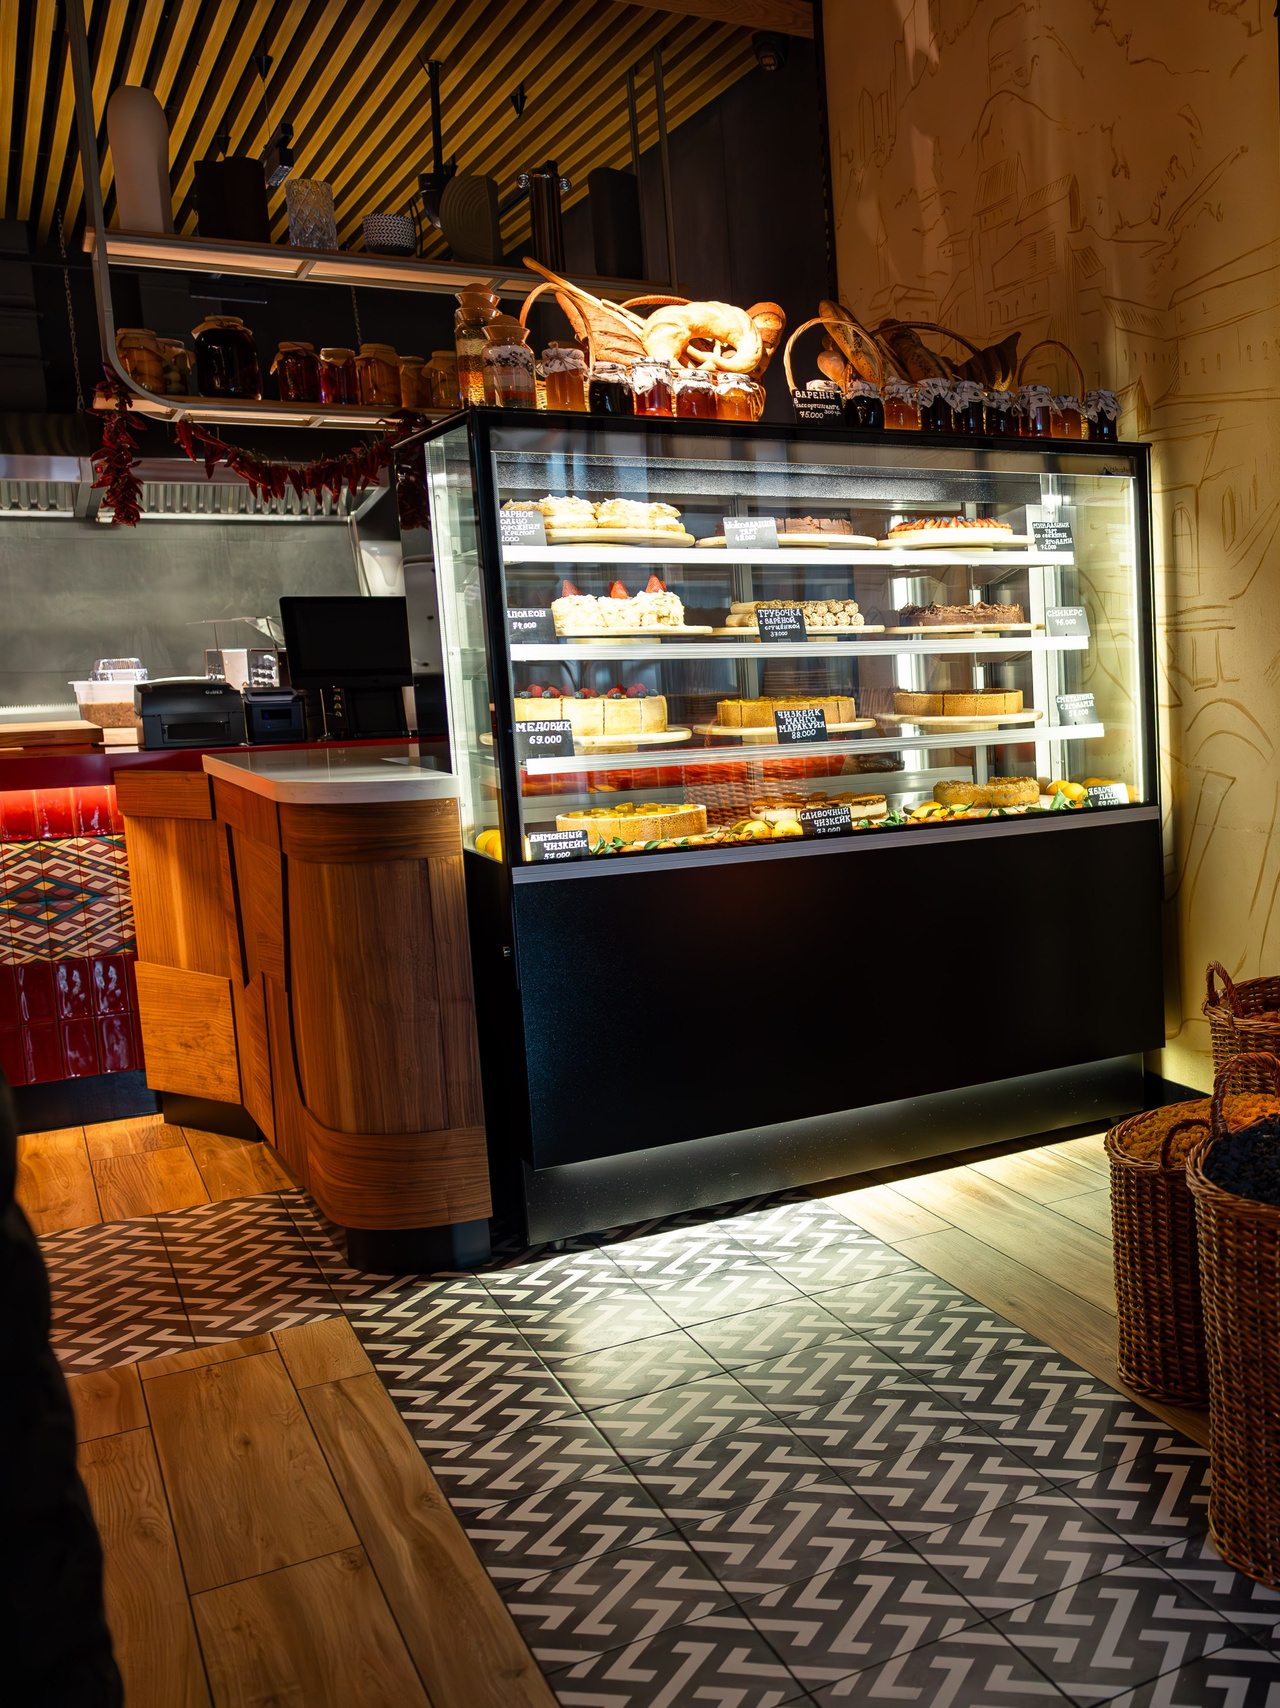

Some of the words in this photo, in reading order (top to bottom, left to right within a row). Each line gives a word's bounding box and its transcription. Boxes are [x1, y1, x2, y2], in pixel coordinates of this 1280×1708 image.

[795, 390, 836, 399] ВАРЕНЬЕ
[758, 609, 802, 618] ТРУБОЧКА
[1047, 609, 1083, 617] СНИКЕРС
[777, 709, 822, 719] ЧИЗКЕЙК
[515, 721, 572, 732] МЕДОВИК
[778, 721, 826, 732] МАРАКУЙЯ
[791, 729, 816, 739] 88.000
[529, 735, 562, 744] 69.000
[800, 807, 850, 820] СЛИВОЧНЫЙ
[813, 815, 852, 827] ЧИЗКЕЙК
[530, 830, 583, 842] ЛИМОННЫЙ
[543, 839, 588, 851] ЧИЗКЕЙК
